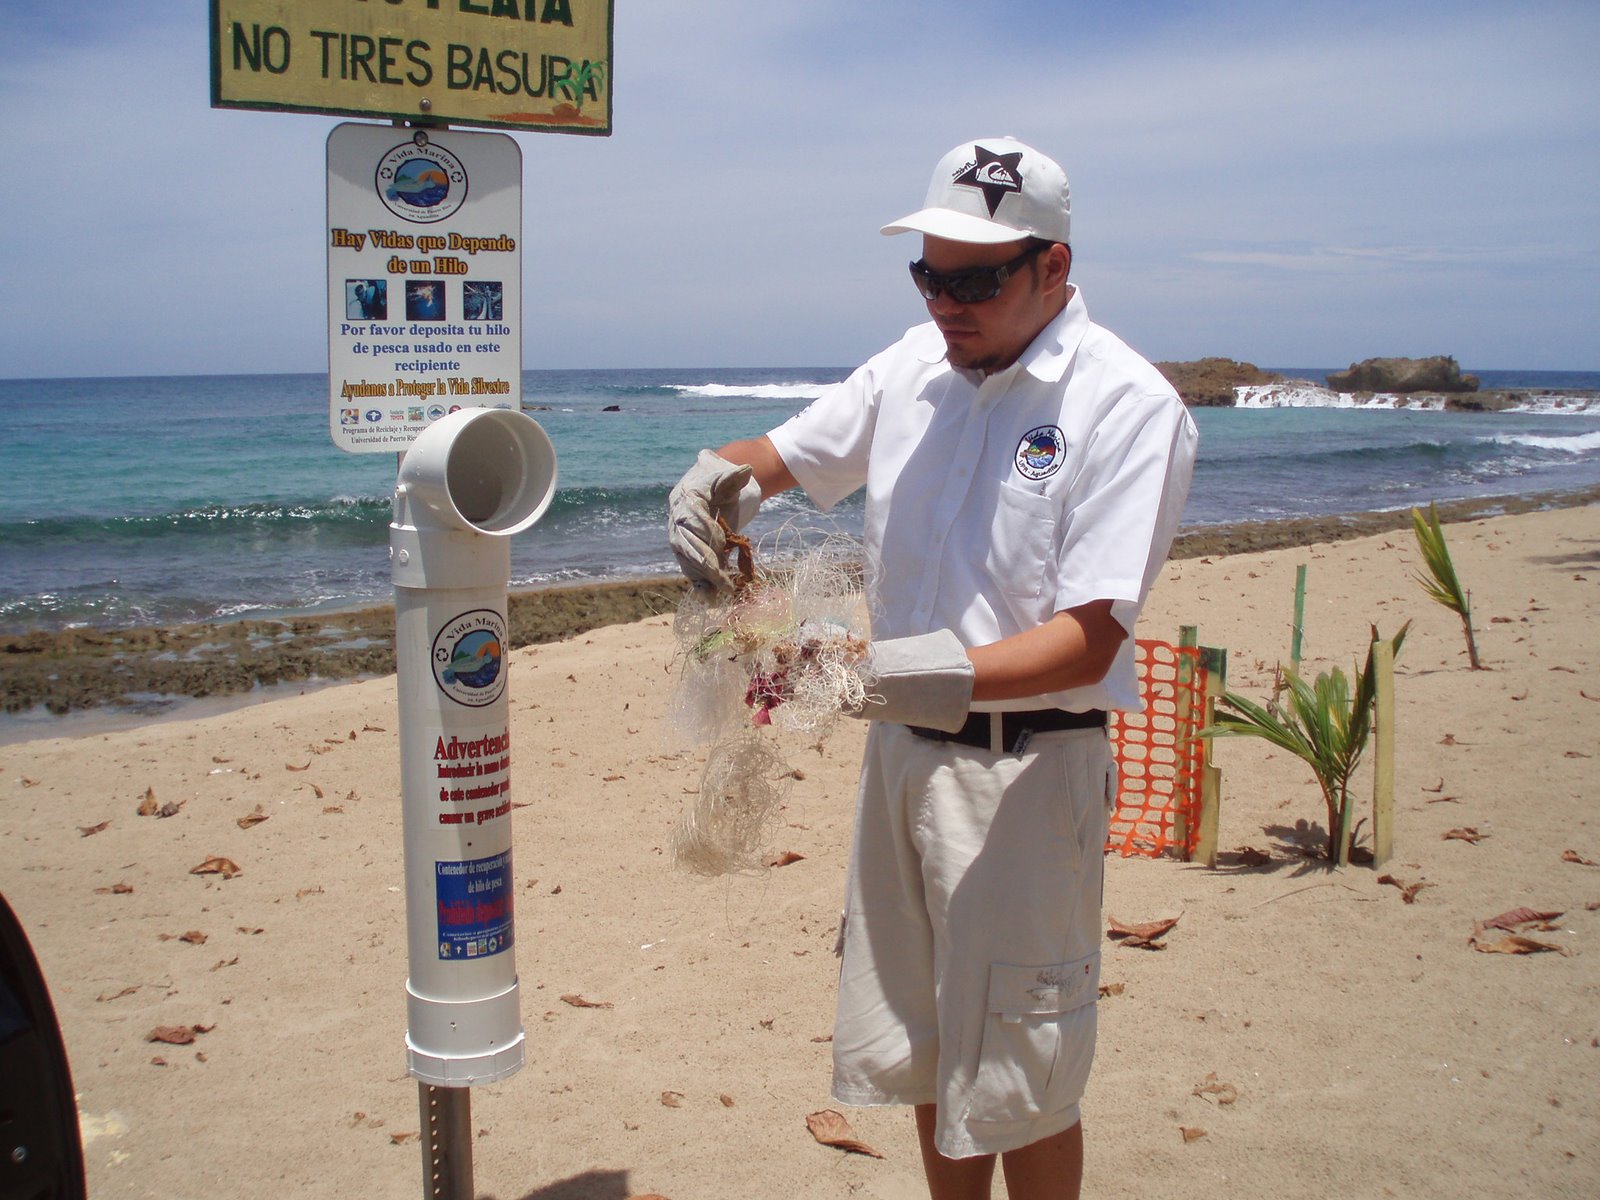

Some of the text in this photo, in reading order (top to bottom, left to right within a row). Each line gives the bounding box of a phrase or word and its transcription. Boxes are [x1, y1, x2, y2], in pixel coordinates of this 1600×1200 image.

[233, 22, 597, 101] NO TIRES BASURA
[389, 148, 455, 169] Vida Marina
[332, 228, 515, 255] Hay Vidas que Depende
[388, 256, 468, 274] de un Hilo
[341, 323, 510, 338] Por favor deposita tu hilo
[353, 342, 500, 356] de pesca usado en este
[395, 360, 460, 373] recipiente
[341, 377, 510, 402] Ayudanos a Proteger la Vida Silvestre
[342, 427, 367, 435] Programa
[376, 426, 398, 434] Reciclaje
[1025, 430, 1043, 444] Vida
[446, 618, 503, 639] Vida Marina
[440, 787, 449, 801] de
[464, 812, 474, 823] un
[477, 808, 494, 825] grave
[438, 862, 468, 875] Contenedor
[468, 861, 475, 874] de
[468, 878, 502, 894] de hilo de pesca
